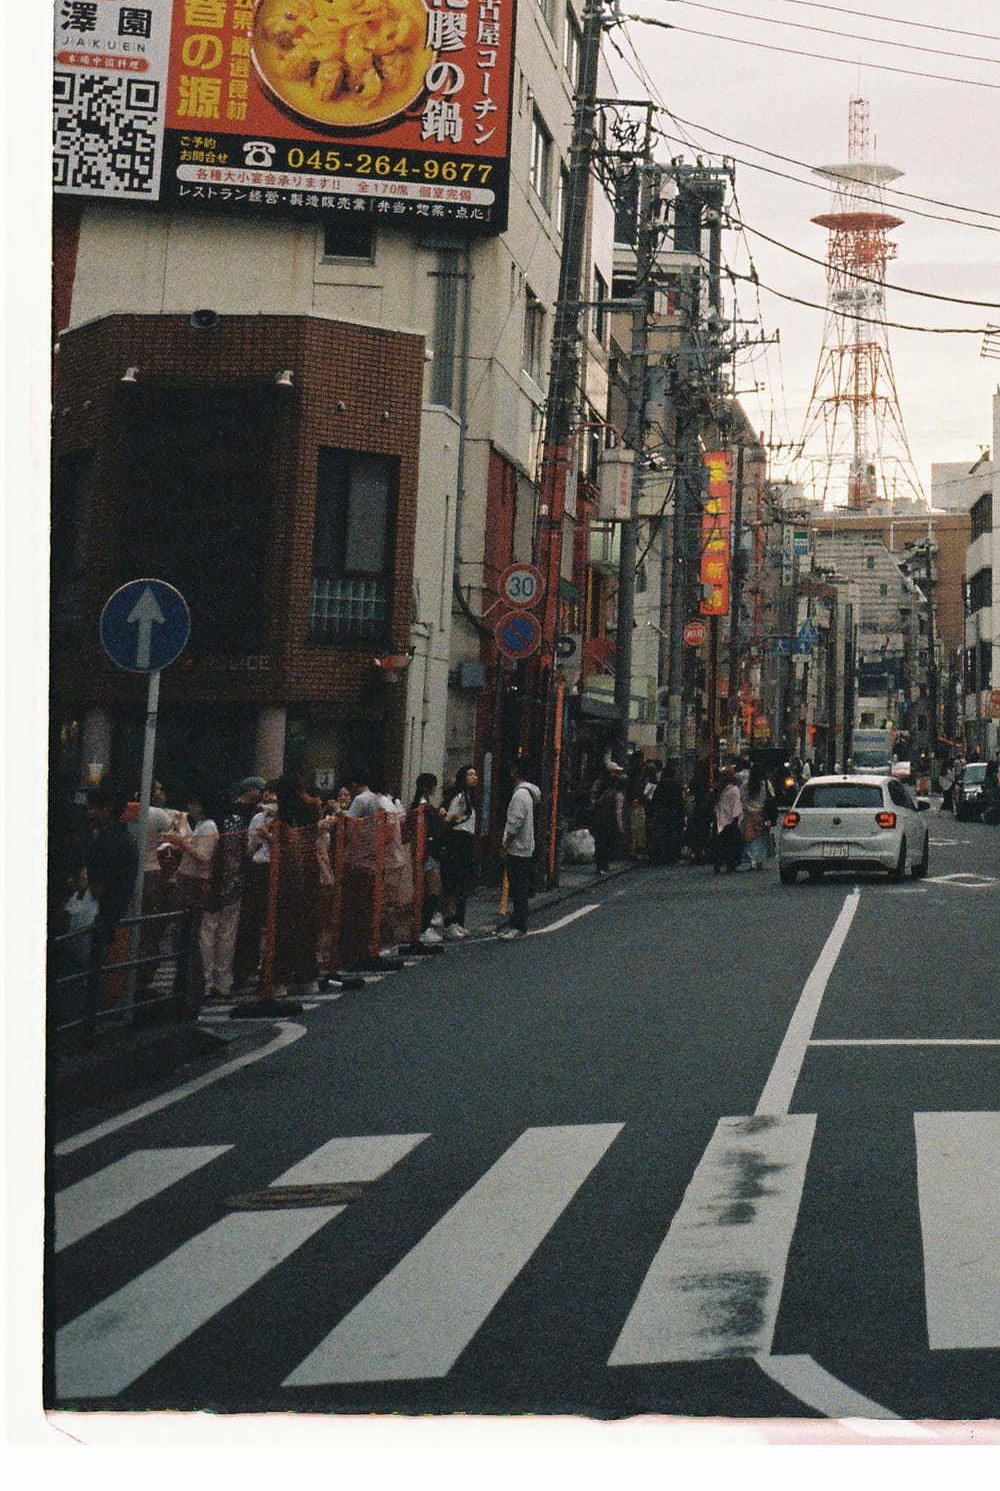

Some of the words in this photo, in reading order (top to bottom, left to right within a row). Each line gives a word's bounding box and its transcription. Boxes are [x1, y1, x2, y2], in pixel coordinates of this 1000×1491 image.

[180, 135, 217, 150] ご予約
[180, 150, 229, 164] お問合せ
[287, 147, 493, 184] 045-264-9677
[509, 576, 534, 597] 30
